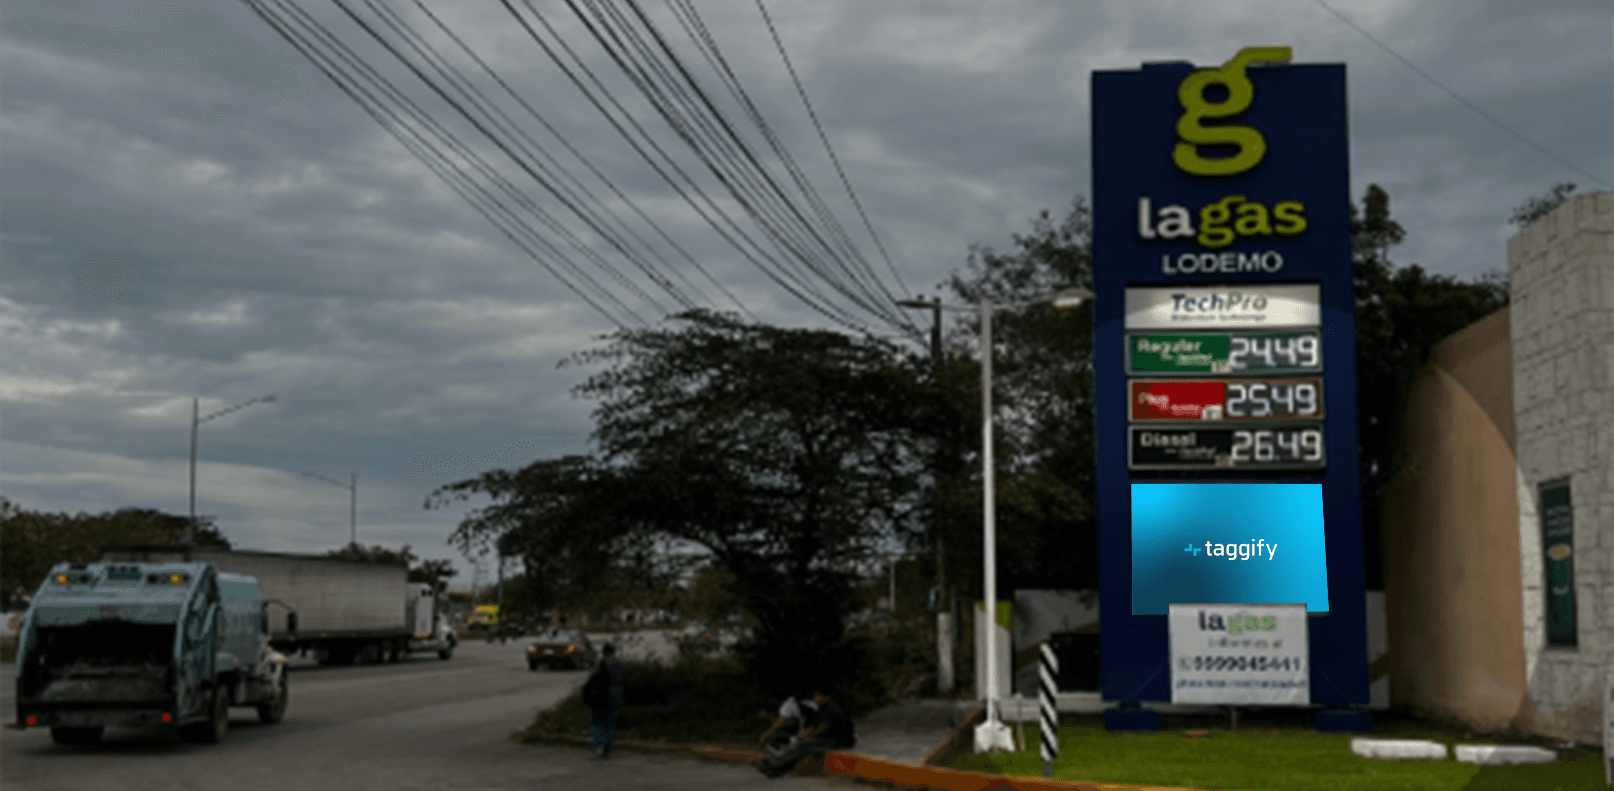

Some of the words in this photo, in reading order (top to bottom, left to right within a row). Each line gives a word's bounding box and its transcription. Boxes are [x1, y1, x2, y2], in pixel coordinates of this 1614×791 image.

[1162, 251, 1284, 274] LODEMO
[1171, 292, 1267, 312] TechPro
[1140, 432, 1197, 447] Diesel
[1205, 538, 1278, 561] taggify
